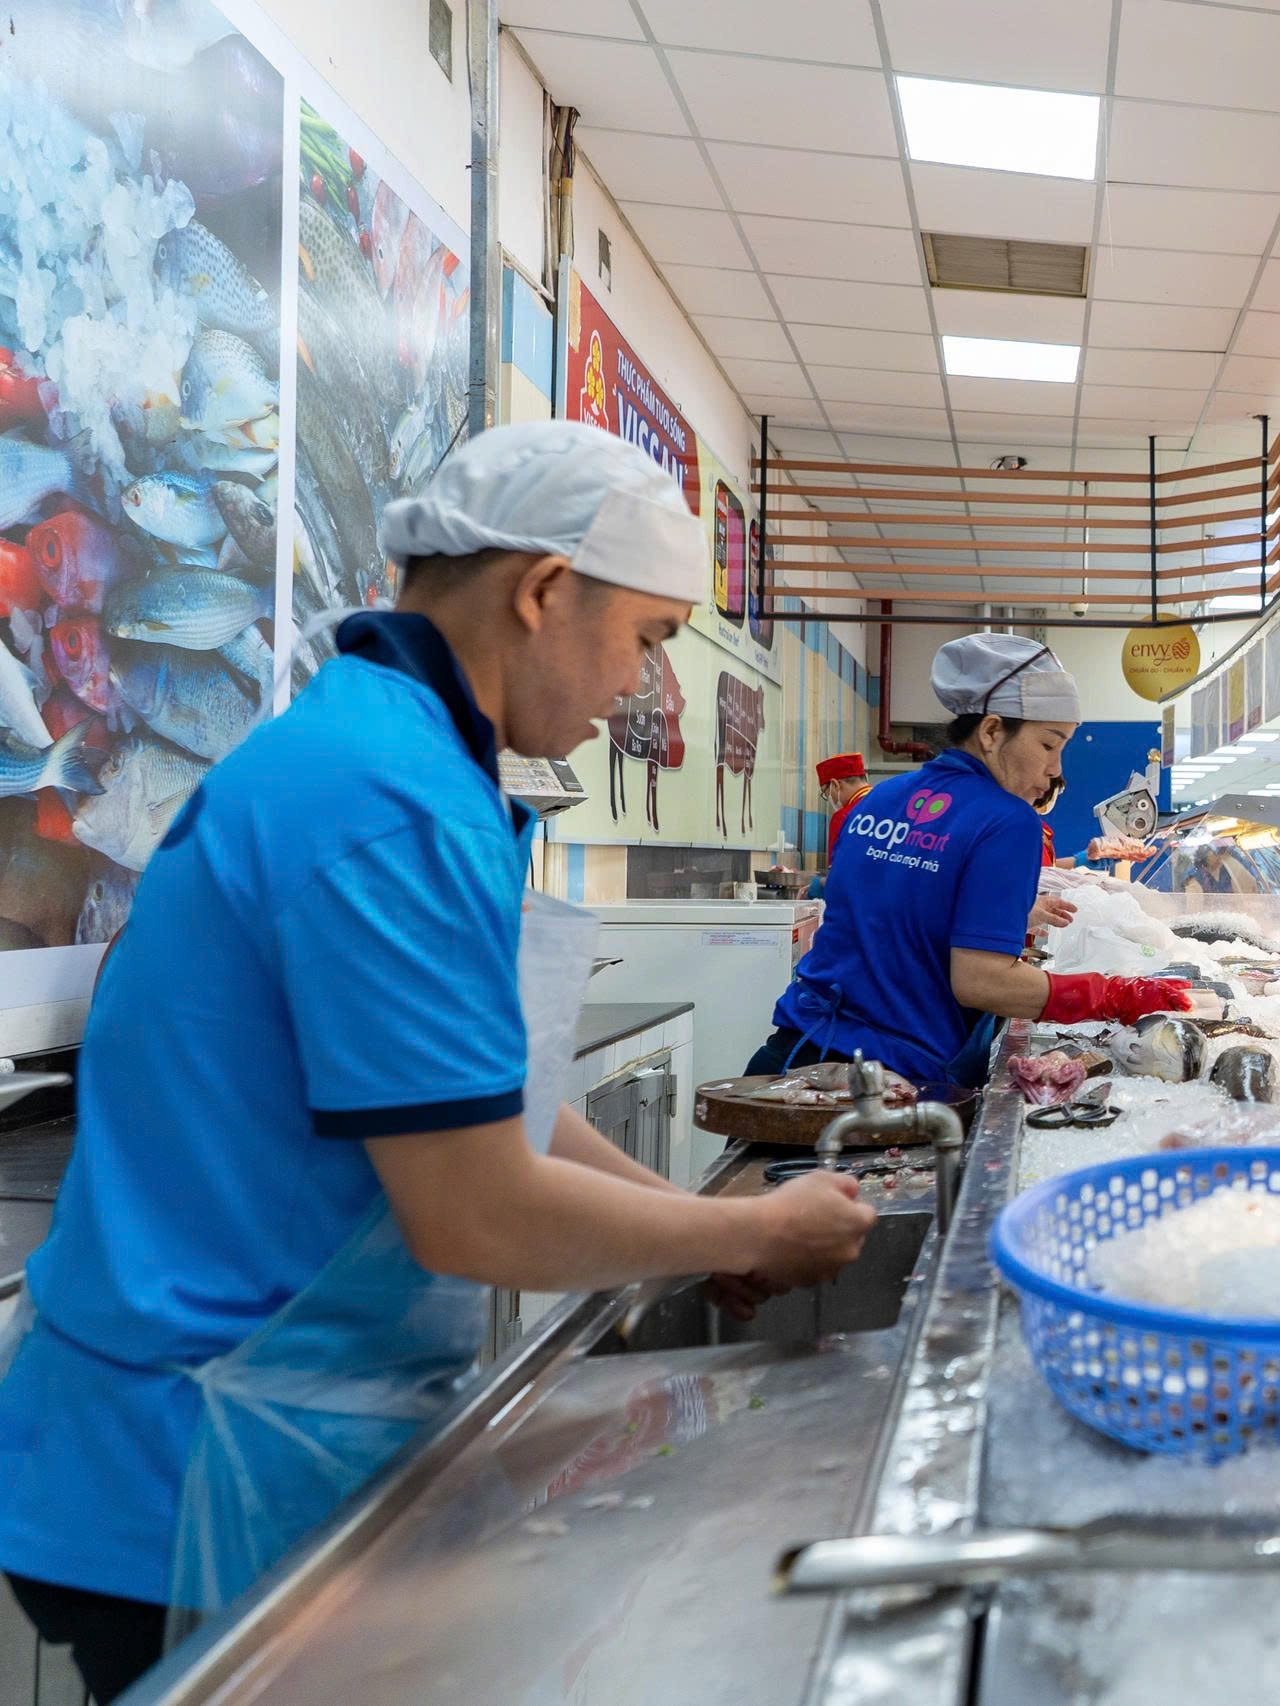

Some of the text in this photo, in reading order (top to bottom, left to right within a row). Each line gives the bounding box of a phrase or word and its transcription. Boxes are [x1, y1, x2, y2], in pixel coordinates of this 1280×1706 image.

[617, 349, 637, 392] THỰC
[1131, 643, 1172, 667] envy
[866, 845, 888, 860] bạn
